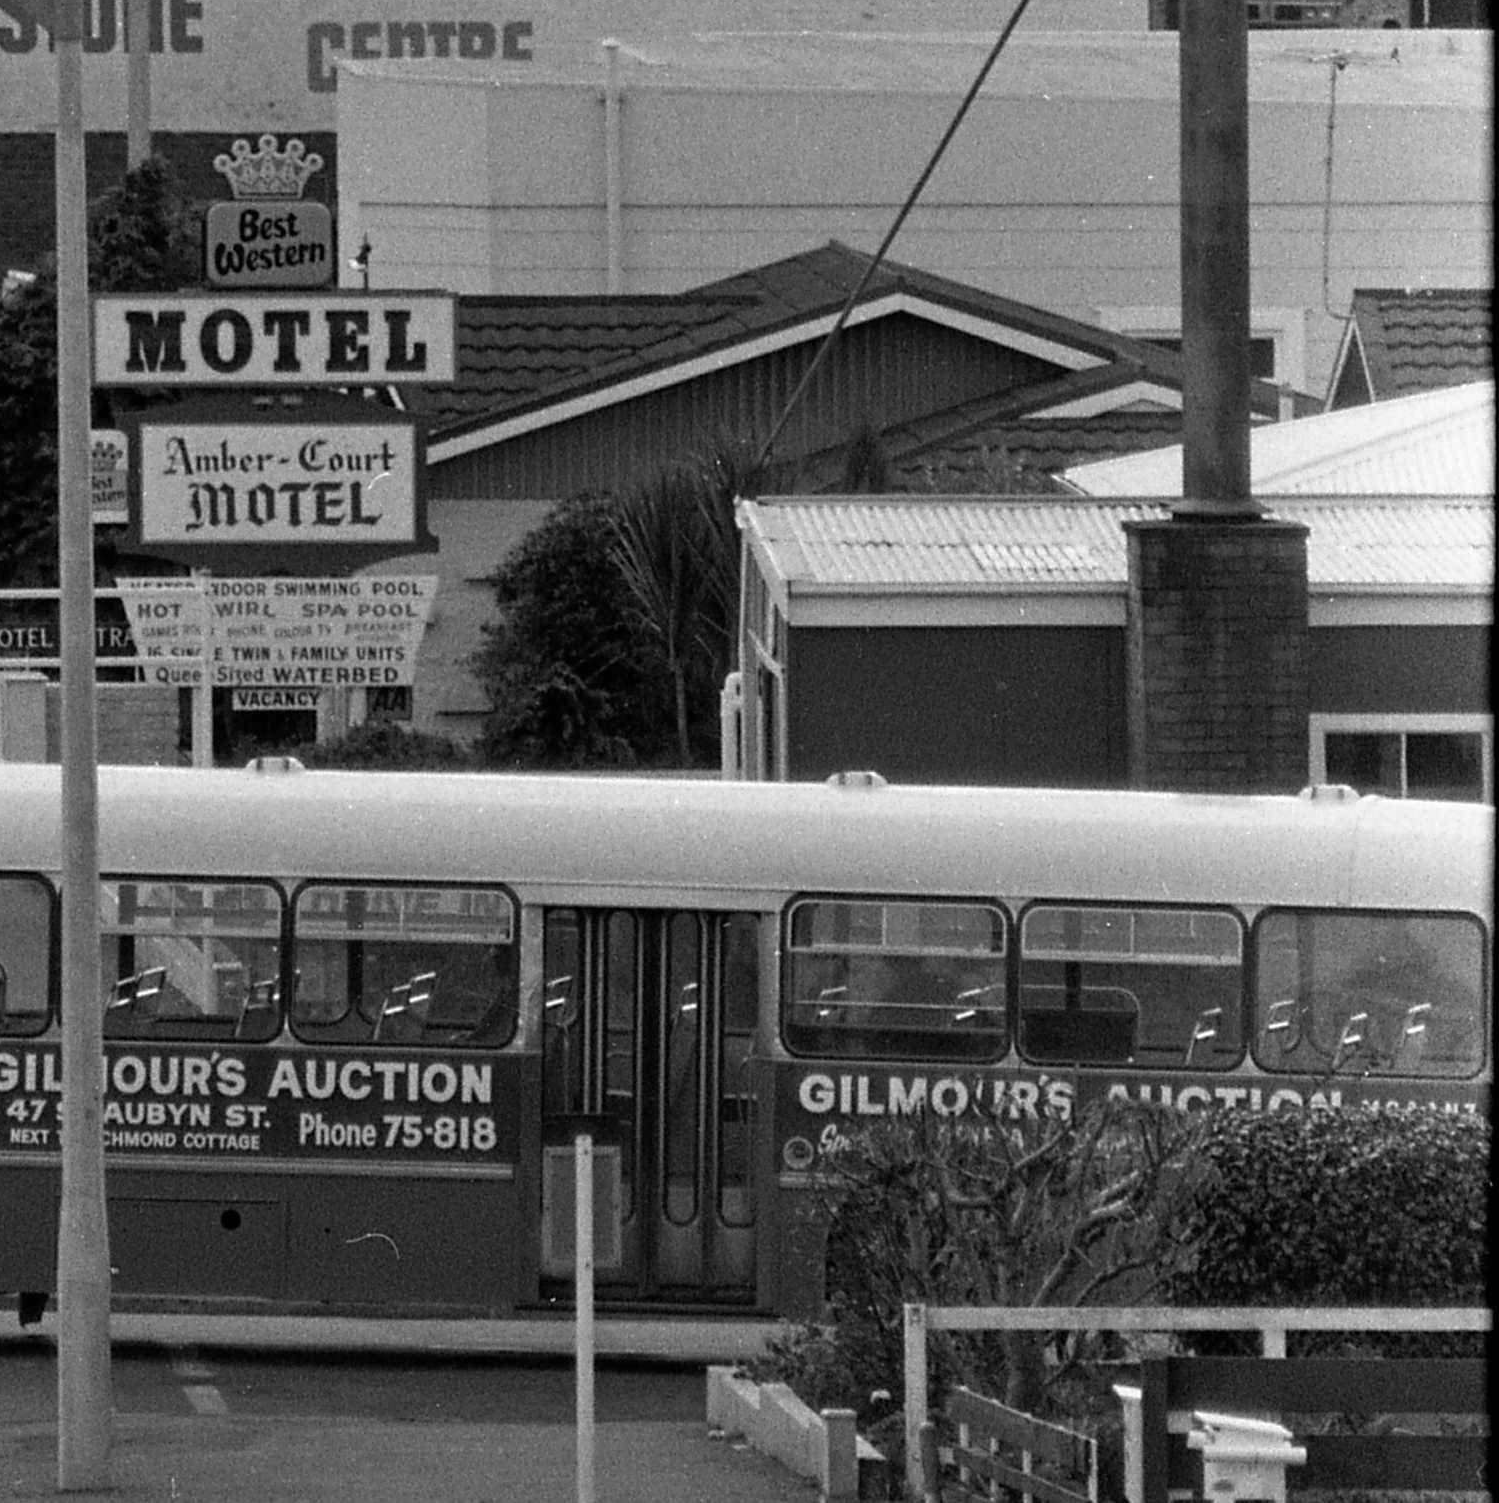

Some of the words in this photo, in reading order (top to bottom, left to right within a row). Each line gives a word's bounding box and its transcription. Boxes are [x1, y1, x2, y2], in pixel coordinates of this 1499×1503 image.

[238, 209, 301, 242] Best
[213, 242, 325, 277] Western
[125, 308, 427, 374] MOTEL
[184, 480, 384, 533] MOTEL
[209, 581, 266, 596] NDOOR
[273, 581, 361, 596] SWIMMING
[137, 602, 183, 619] HOT
[301, 603, 349, 619] SPA
[357, 602, 419, 618] POOL
[231, 646, 271, 662] TWIN
[290, 645, 349, 662] FAMILY
[356, 645, 406, 662] UNITS
[155, 666, 202, 685] Quee
[271, 666, 399, 685] WATERBED
[236, 691, 322, 709] VACANCY
[267, 1059, 493, 1104] AUCTION
[6, 1098, 48, 1122] 47
[102, 1101, 212, 1128] AUBYN
[225, 1104, 272, 1130] ST.
[299, 1112, 377, 1147] Phone
[9, 1127, 50, 1145] NEXT
[102, 1130, 178, 1148] CHMOND
[182, 1131, 262, 1151] COTTAGE
